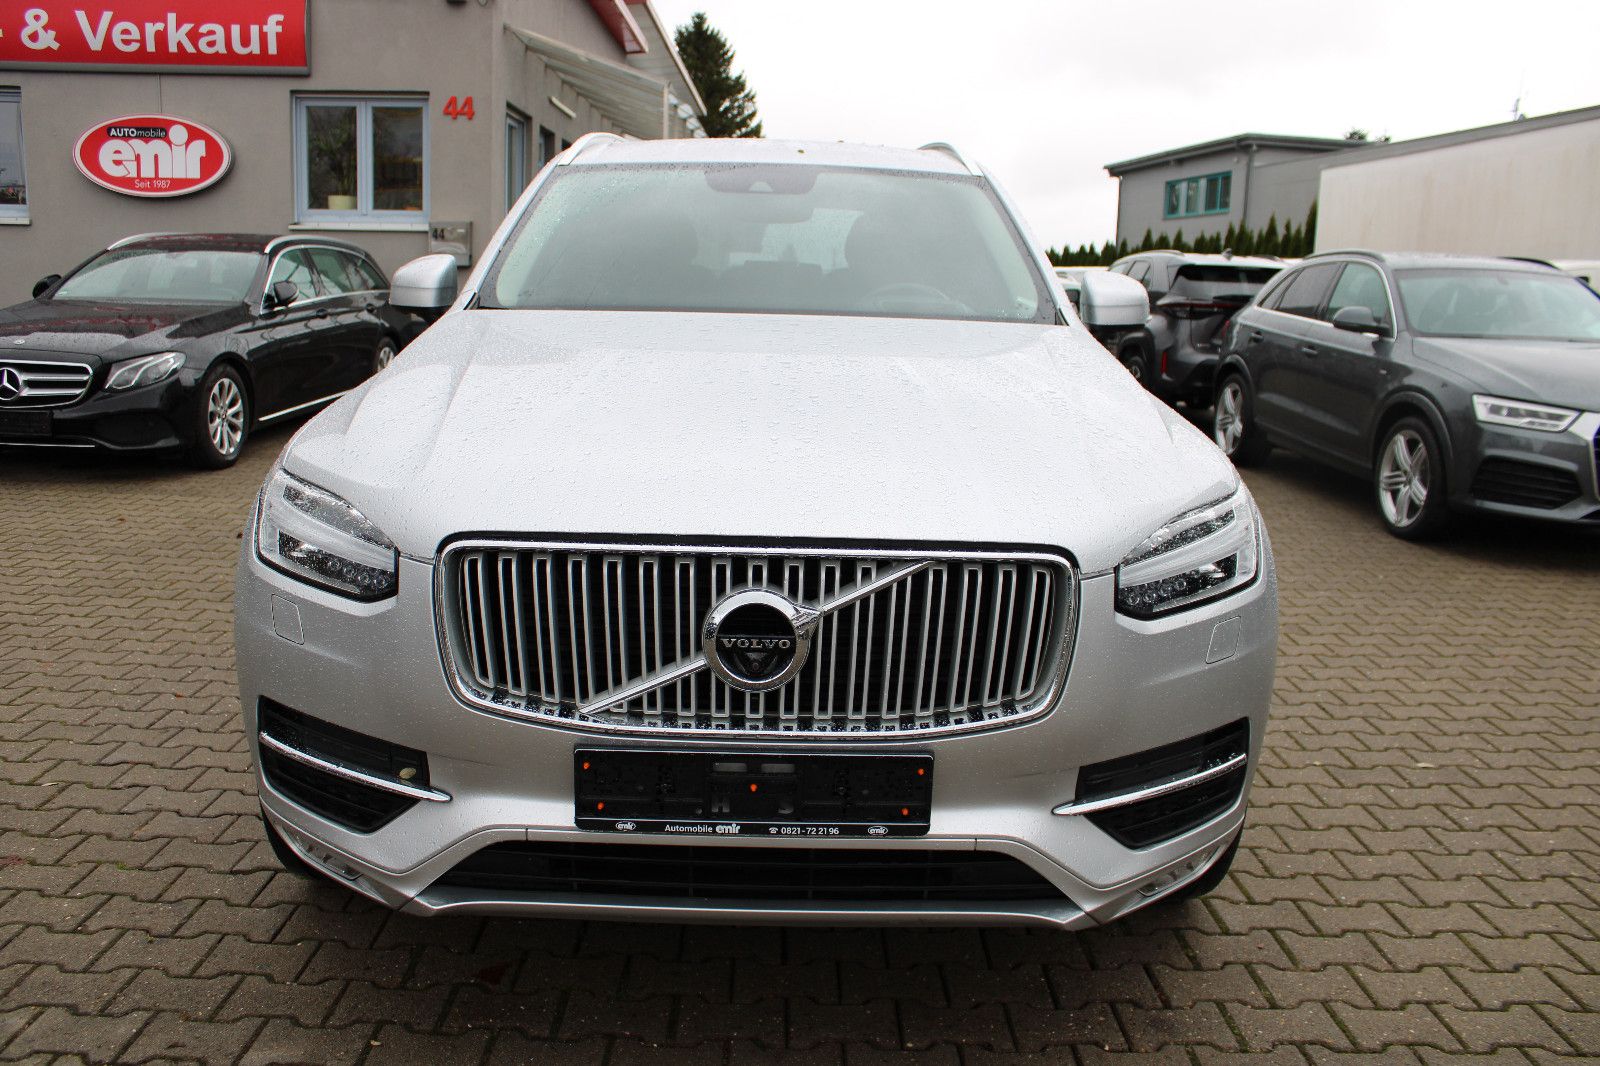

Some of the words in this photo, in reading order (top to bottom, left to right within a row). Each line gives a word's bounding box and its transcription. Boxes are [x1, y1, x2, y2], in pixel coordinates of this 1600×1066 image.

[21, 8, 60, 50] &
[75, 11, 284, 55] Verkauf
[443, 95, 475, 120] 44
[109, 127, 166, 138] AUTOmobile
[98, 124, 207, 179] emir
[134, 180, 151, 189] Seit
[153, 180, 171, 189] 1987
[432, 228, 445, 240] 44
[721, 638, 791, 649] VOLVO
[664, 824, 713, 834] Automobile
[715, 822, 741, 834] emir
